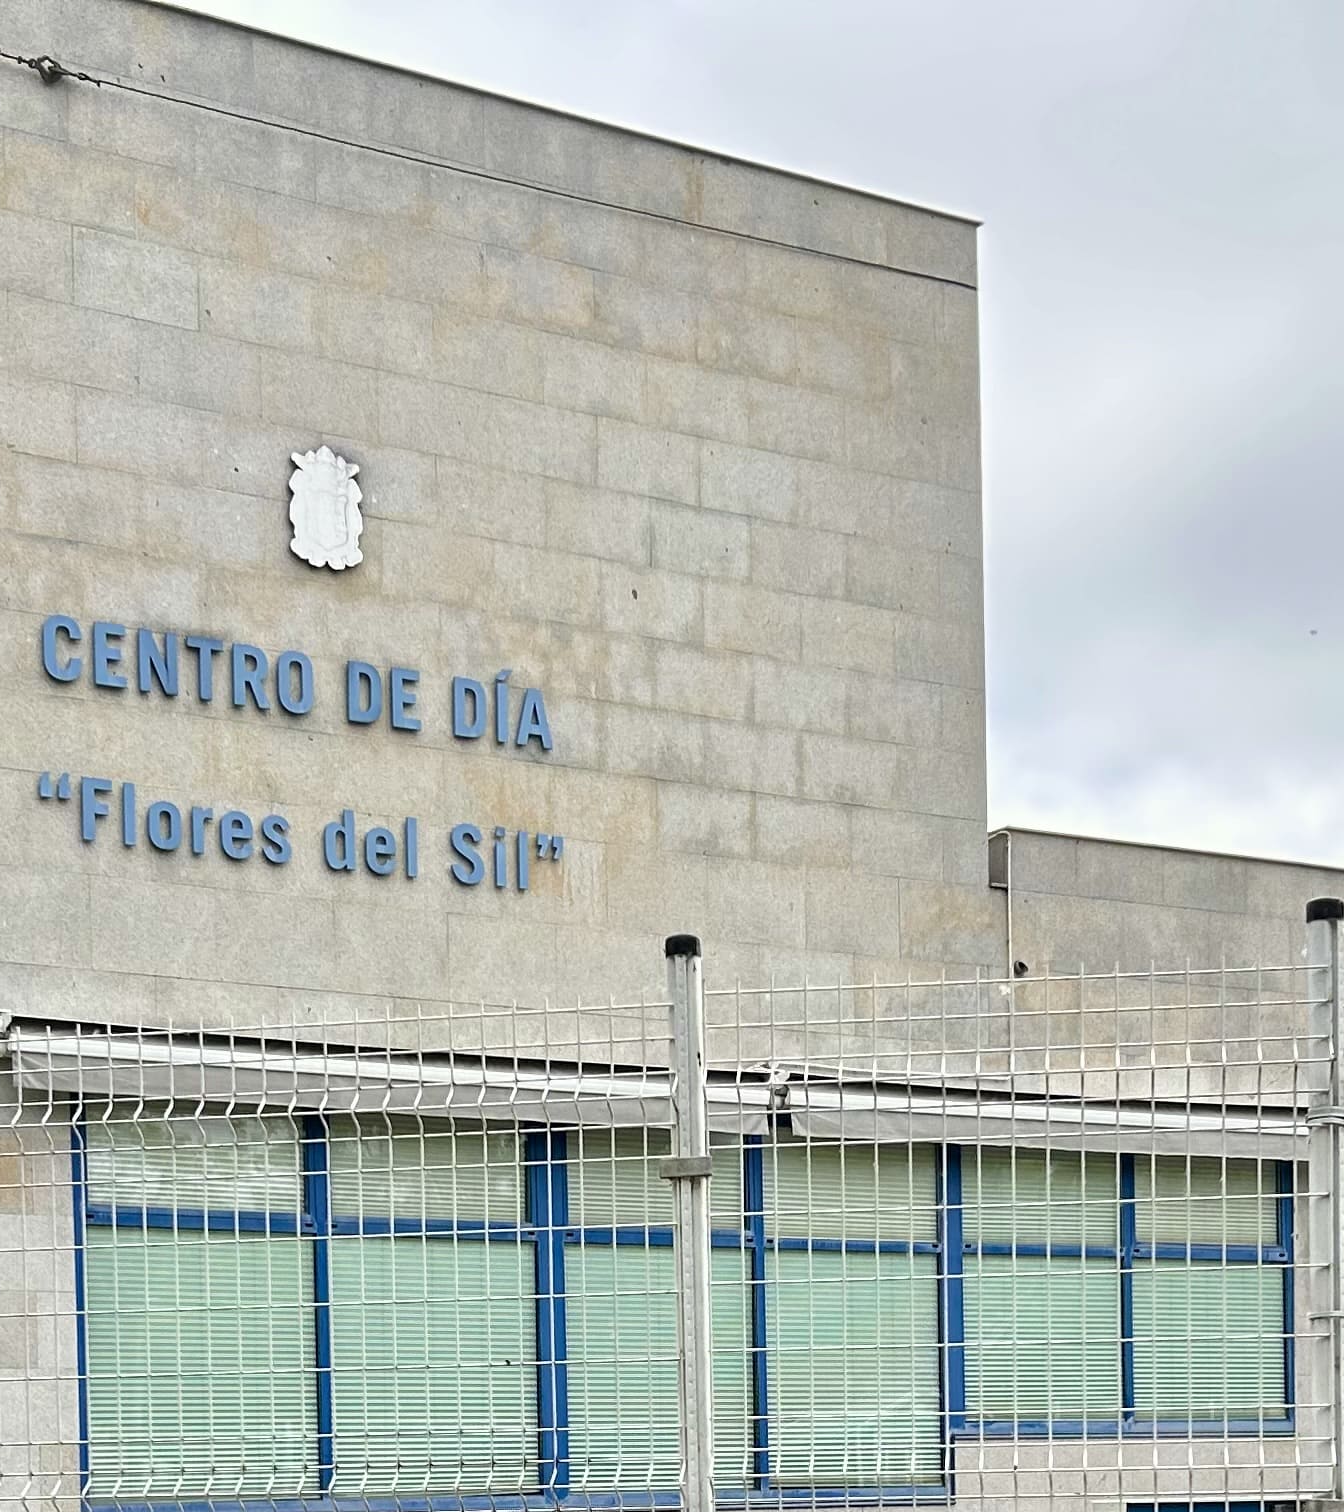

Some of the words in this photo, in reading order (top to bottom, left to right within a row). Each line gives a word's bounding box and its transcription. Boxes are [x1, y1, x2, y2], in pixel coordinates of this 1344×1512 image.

[42, 613, 315, 716] CENTRO
[346, 659, 423, 734] DE
[452, 668, 553, 751] DÍA
[323, 808, 419, 879] del
